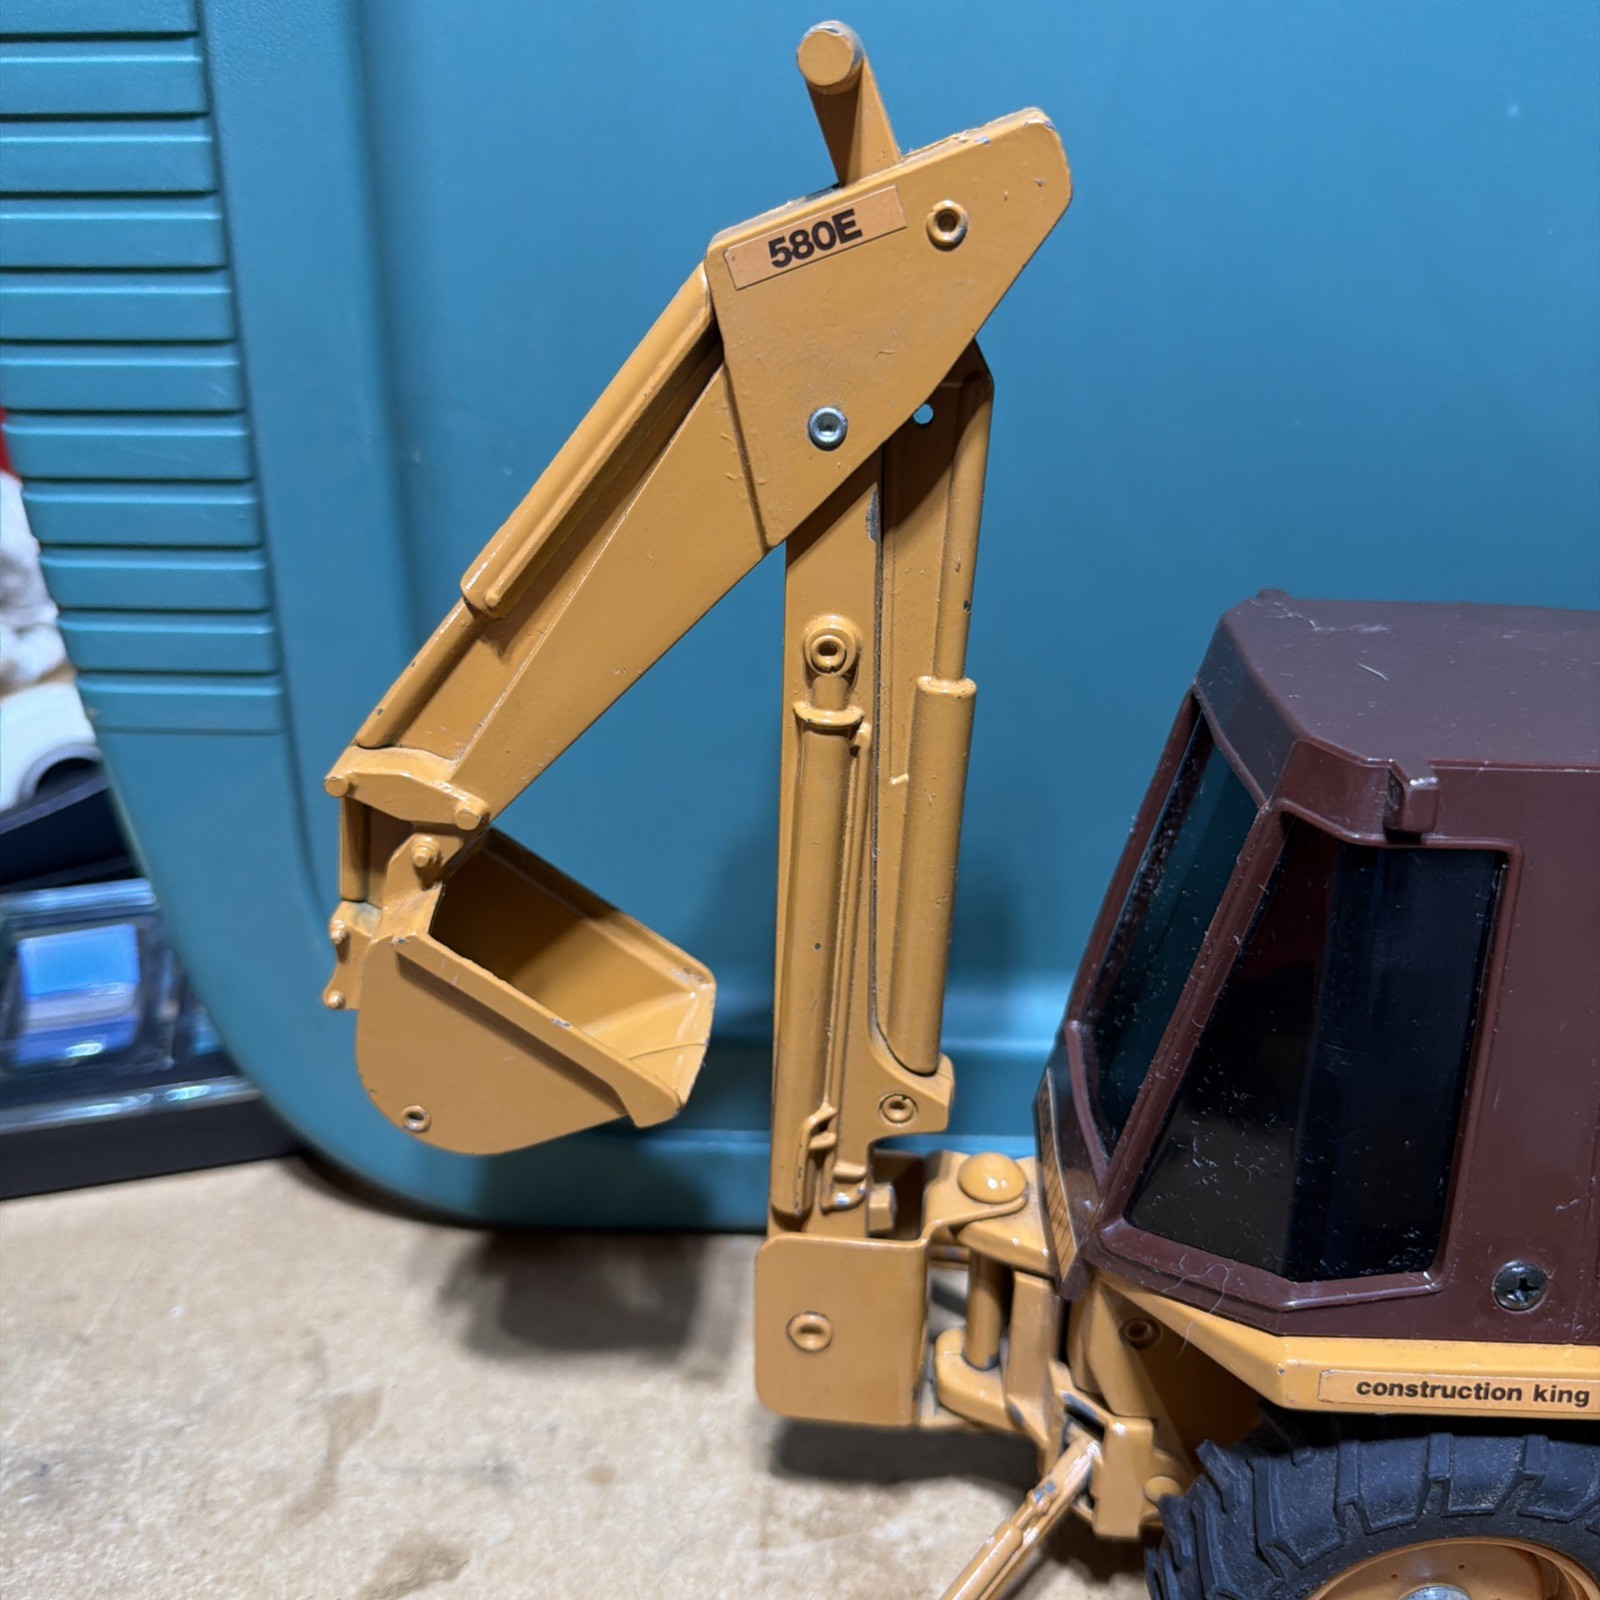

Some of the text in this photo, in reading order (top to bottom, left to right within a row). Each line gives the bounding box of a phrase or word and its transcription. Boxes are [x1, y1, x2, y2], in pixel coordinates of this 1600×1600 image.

[769, 208, 863, 268] 580E
[1356, 1381, 1590, 1407] construction king
